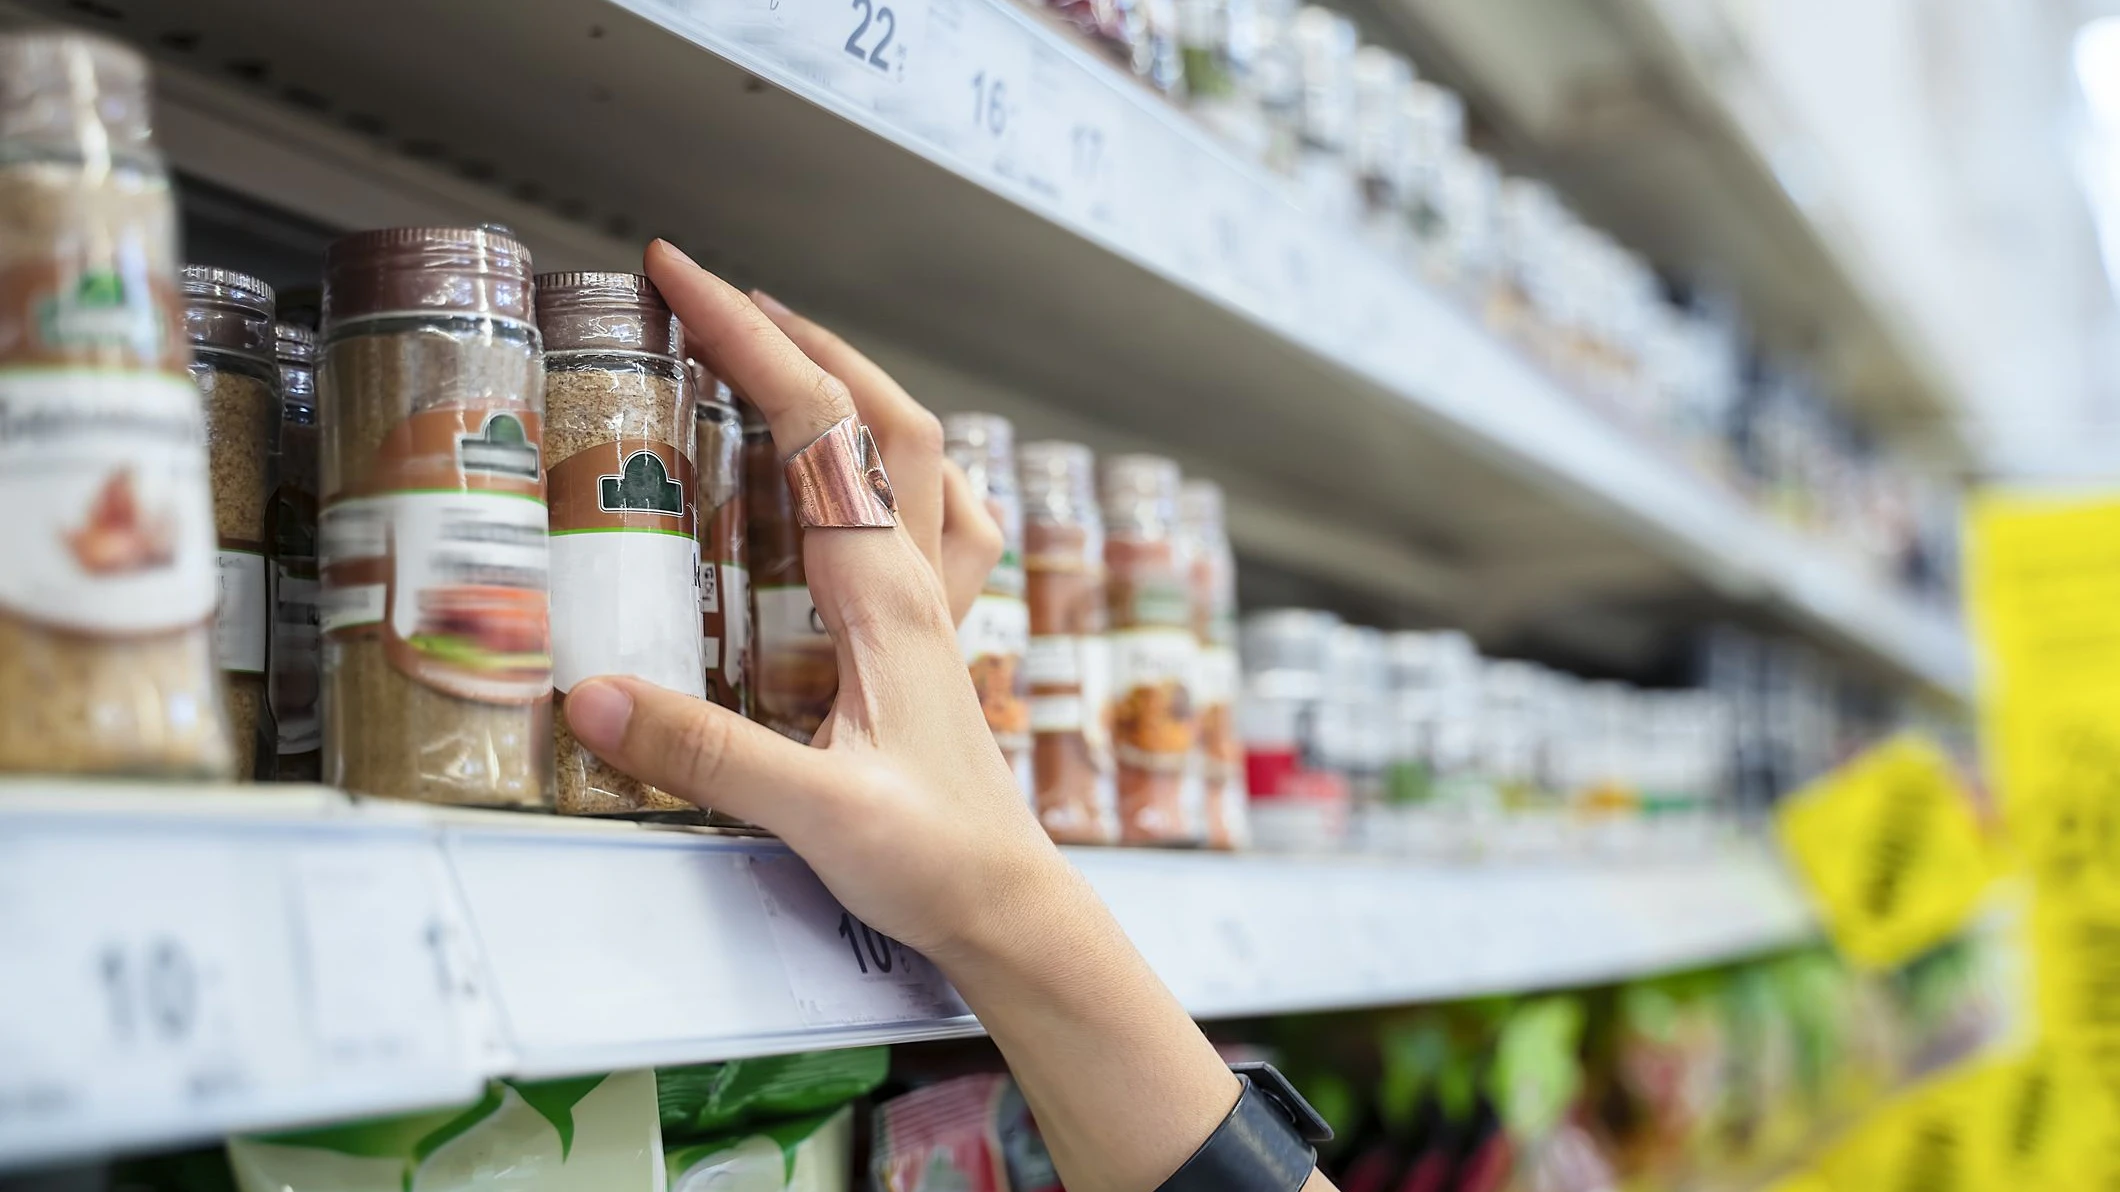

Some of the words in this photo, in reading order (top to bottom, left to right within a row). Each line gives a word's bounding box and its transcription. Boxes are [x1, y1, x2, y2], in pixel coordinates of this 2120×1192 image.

[845, 0, 895, 71] 22
[970, 68, 1007, 136] 16
[97, 936, 197, 1047] 10
